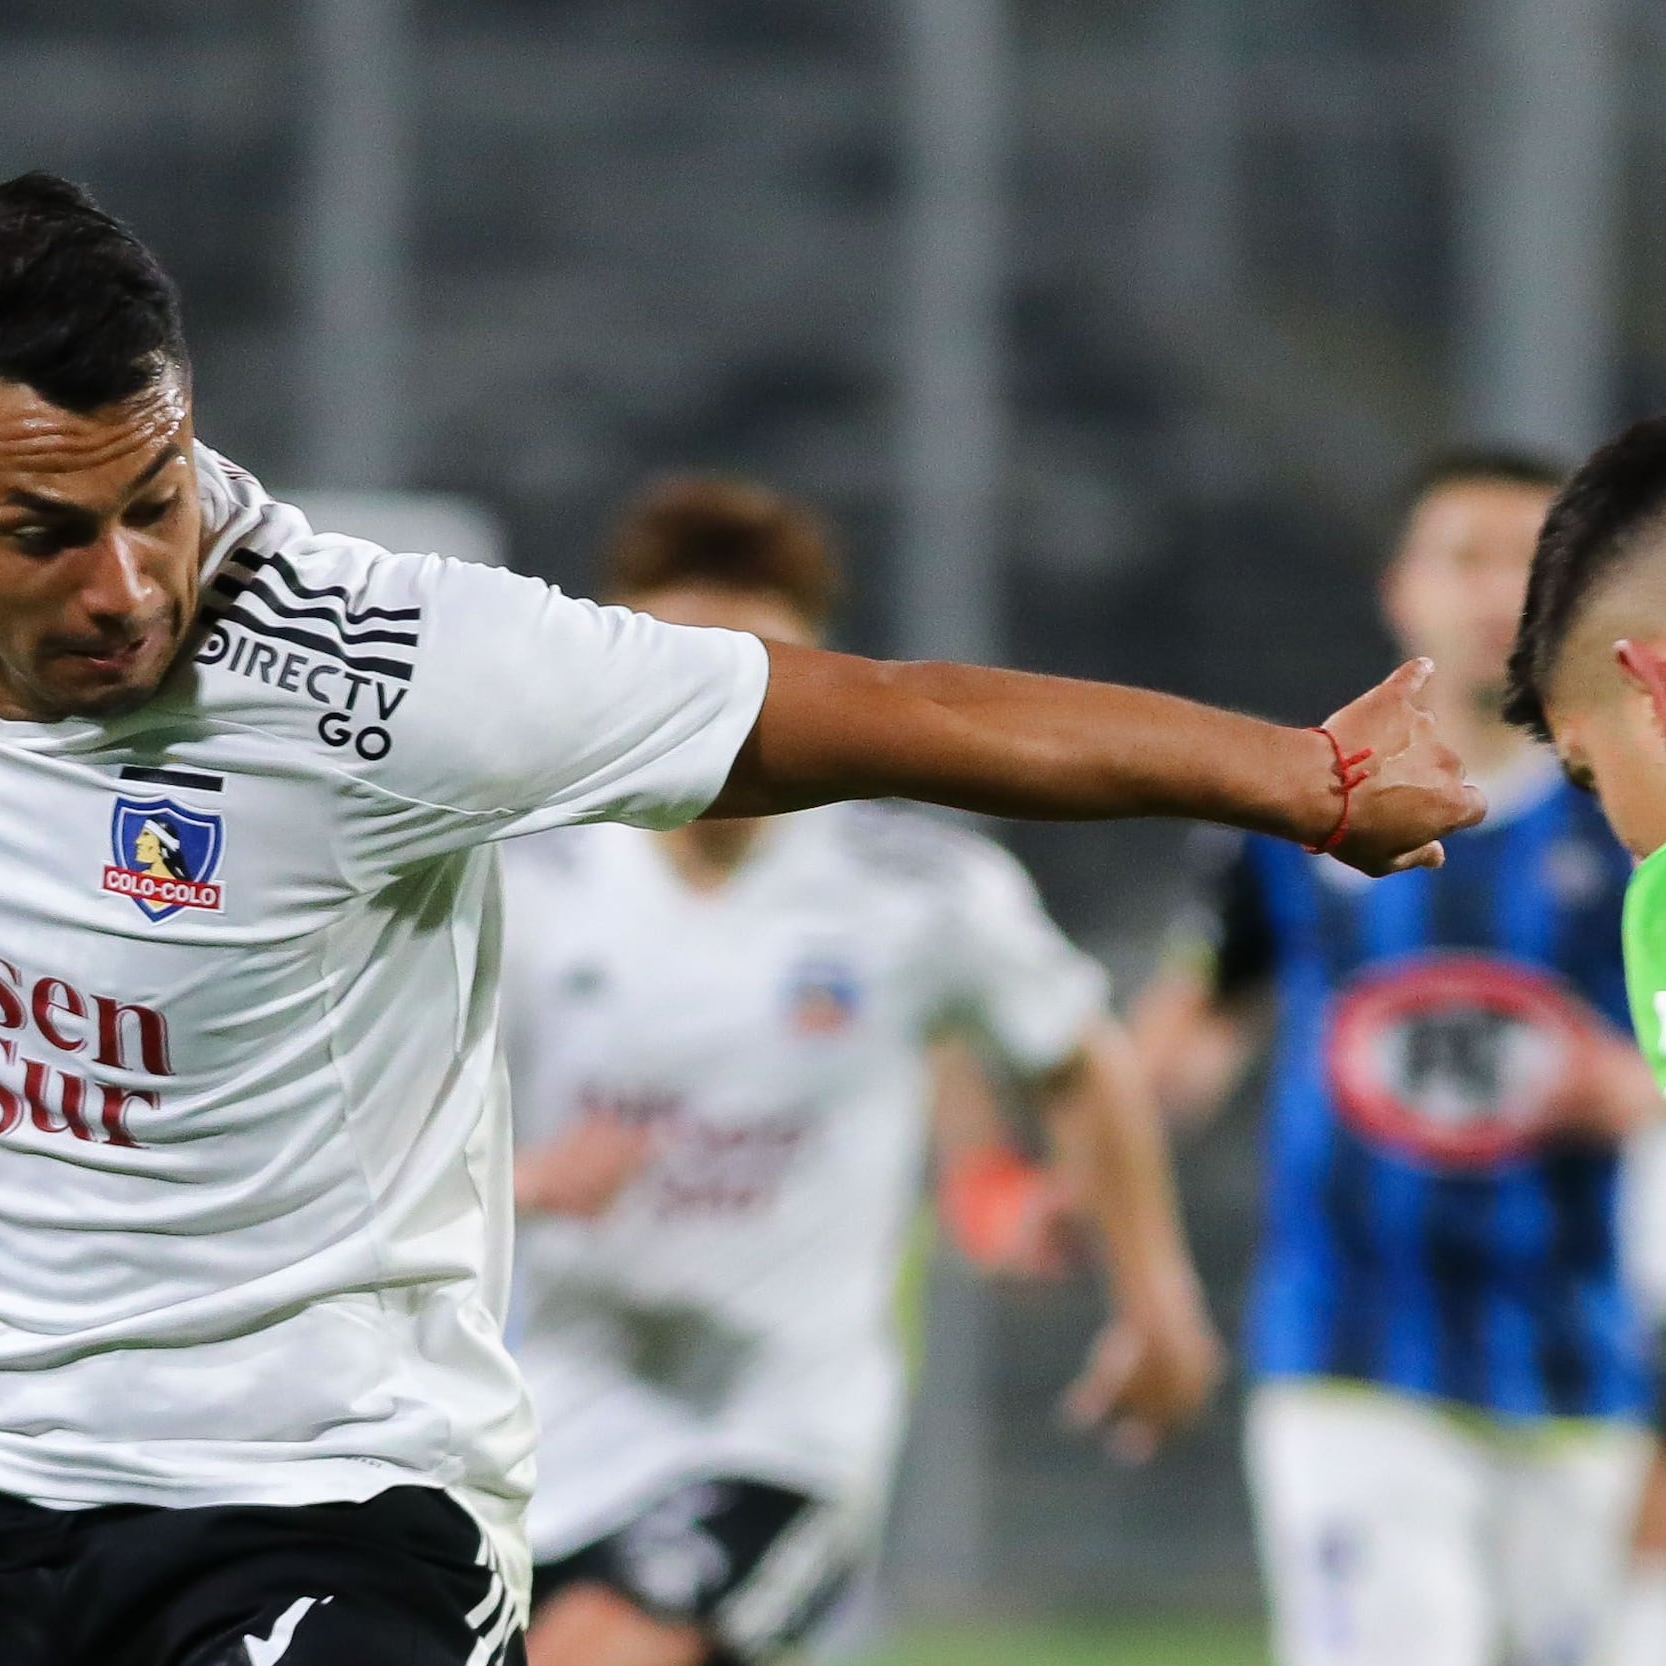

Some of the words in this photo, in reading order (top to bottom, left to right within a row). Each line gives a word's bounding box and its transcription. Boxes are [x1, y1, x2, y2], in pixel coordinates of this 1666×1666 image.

[193, 623, 409, 721] DIRECTV
[318, 712, 392, 761] GO
[106, 870, 217, 906] COLO-COLO
